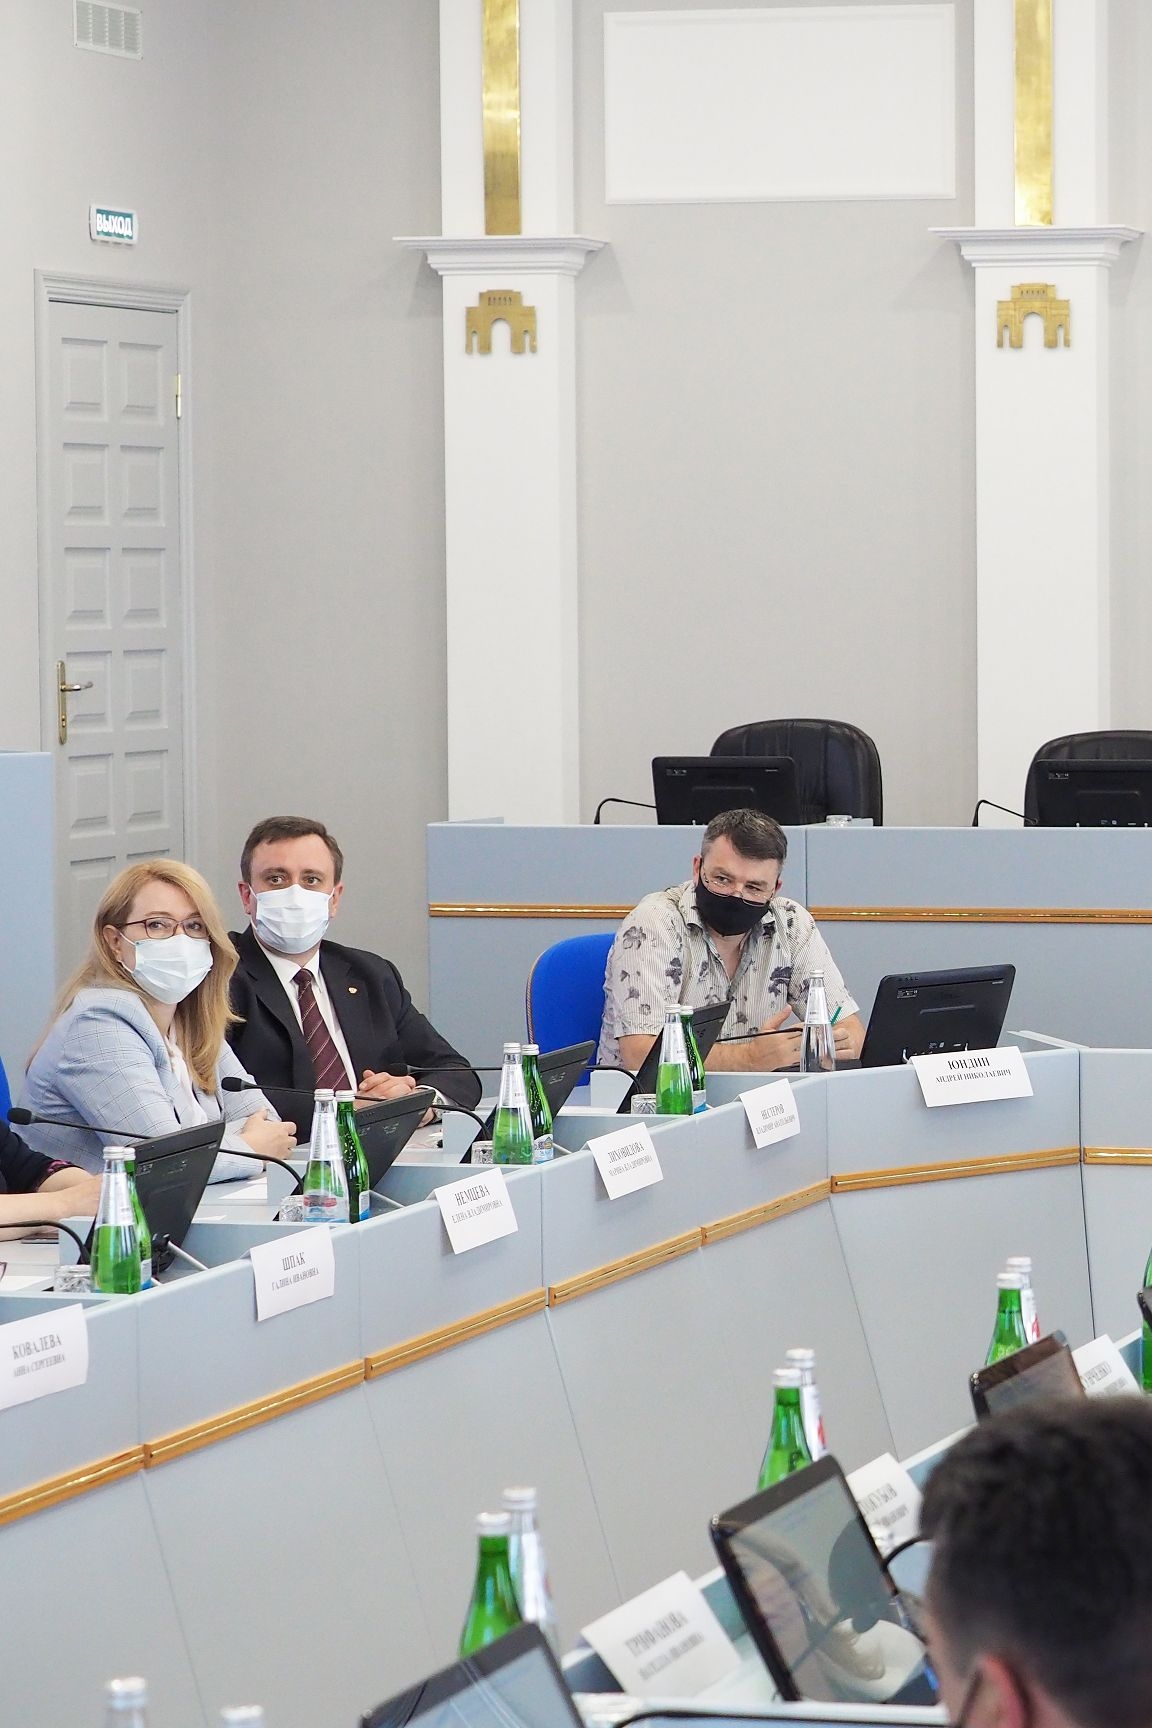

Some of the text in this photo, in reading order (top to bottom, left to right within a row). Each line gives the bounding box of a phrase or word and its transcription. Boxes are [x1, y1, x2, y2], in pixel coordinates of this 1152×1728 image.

[96, 213, 132, 236] ВЫХОД
[947, 1057, 990, 1070] ЮНДИН
[935, 1068, 1012, 1083] АНДРЕЙ НИКОЛАЕВИЧ
[760, 1103, 785, 1120] НЕСТЕРОВ
[454, 1184, 491, 1207] НЕМЦЕВА
[281, 1251, 306, 1271] ШПАК
[12, 1333, 62, 1360] КОВАЛЕВА
